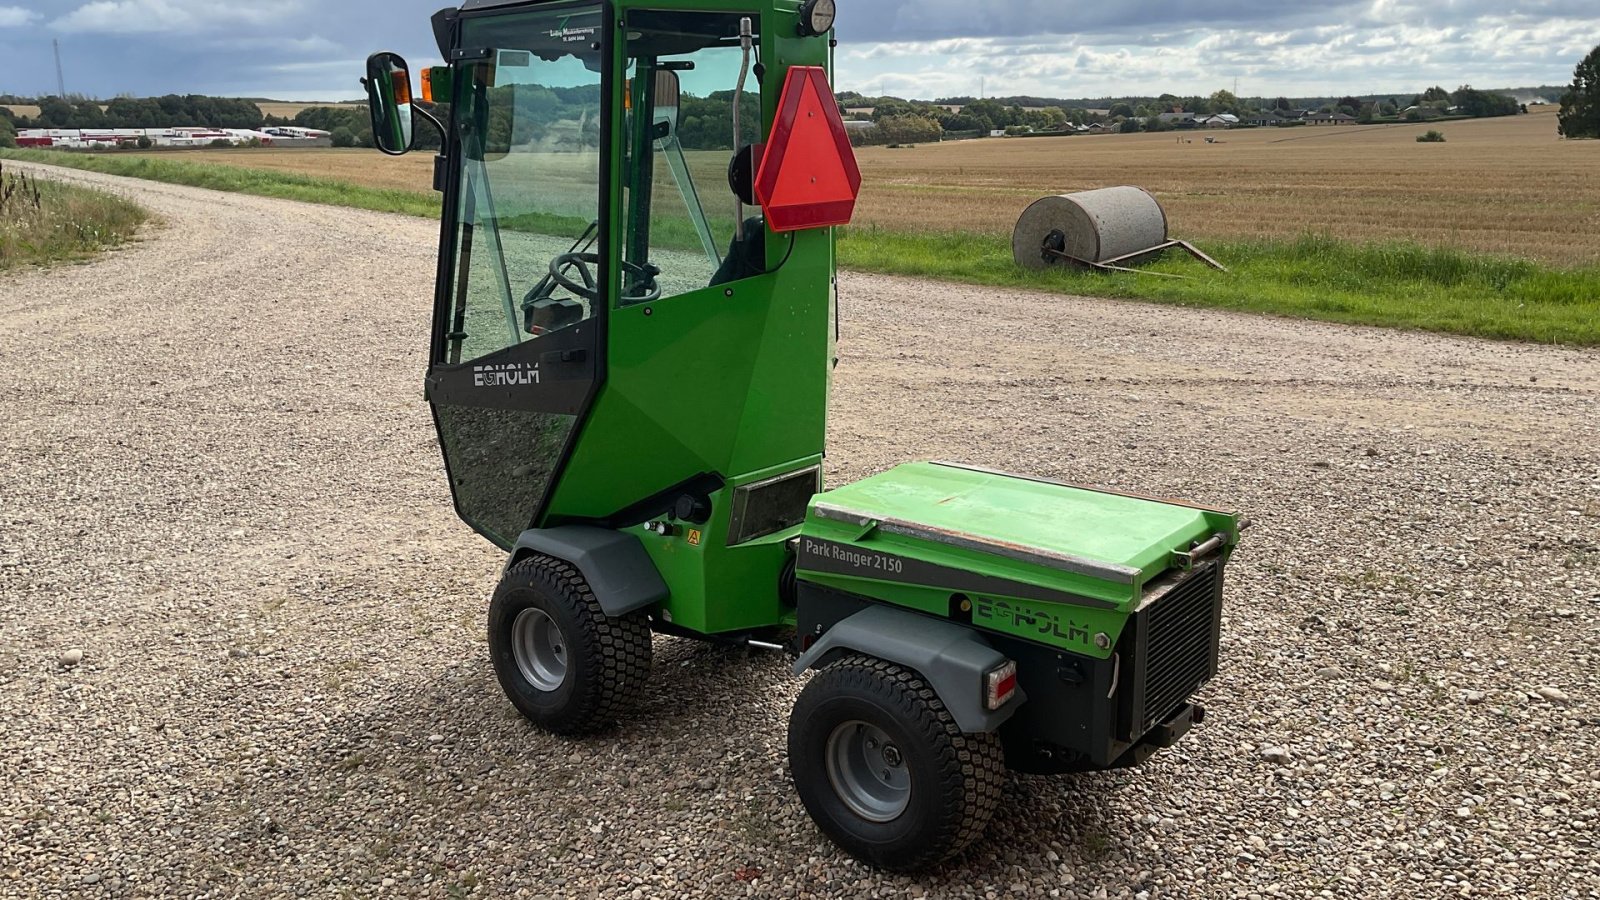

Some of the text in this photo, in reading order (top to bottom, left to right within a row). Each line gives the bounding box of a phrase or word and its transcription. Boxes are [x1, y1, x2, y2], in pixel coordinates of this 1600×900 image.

[474, 362, 540, 386] EGHOLM
[806, 540, 902, 573] Park Ranger 2150
